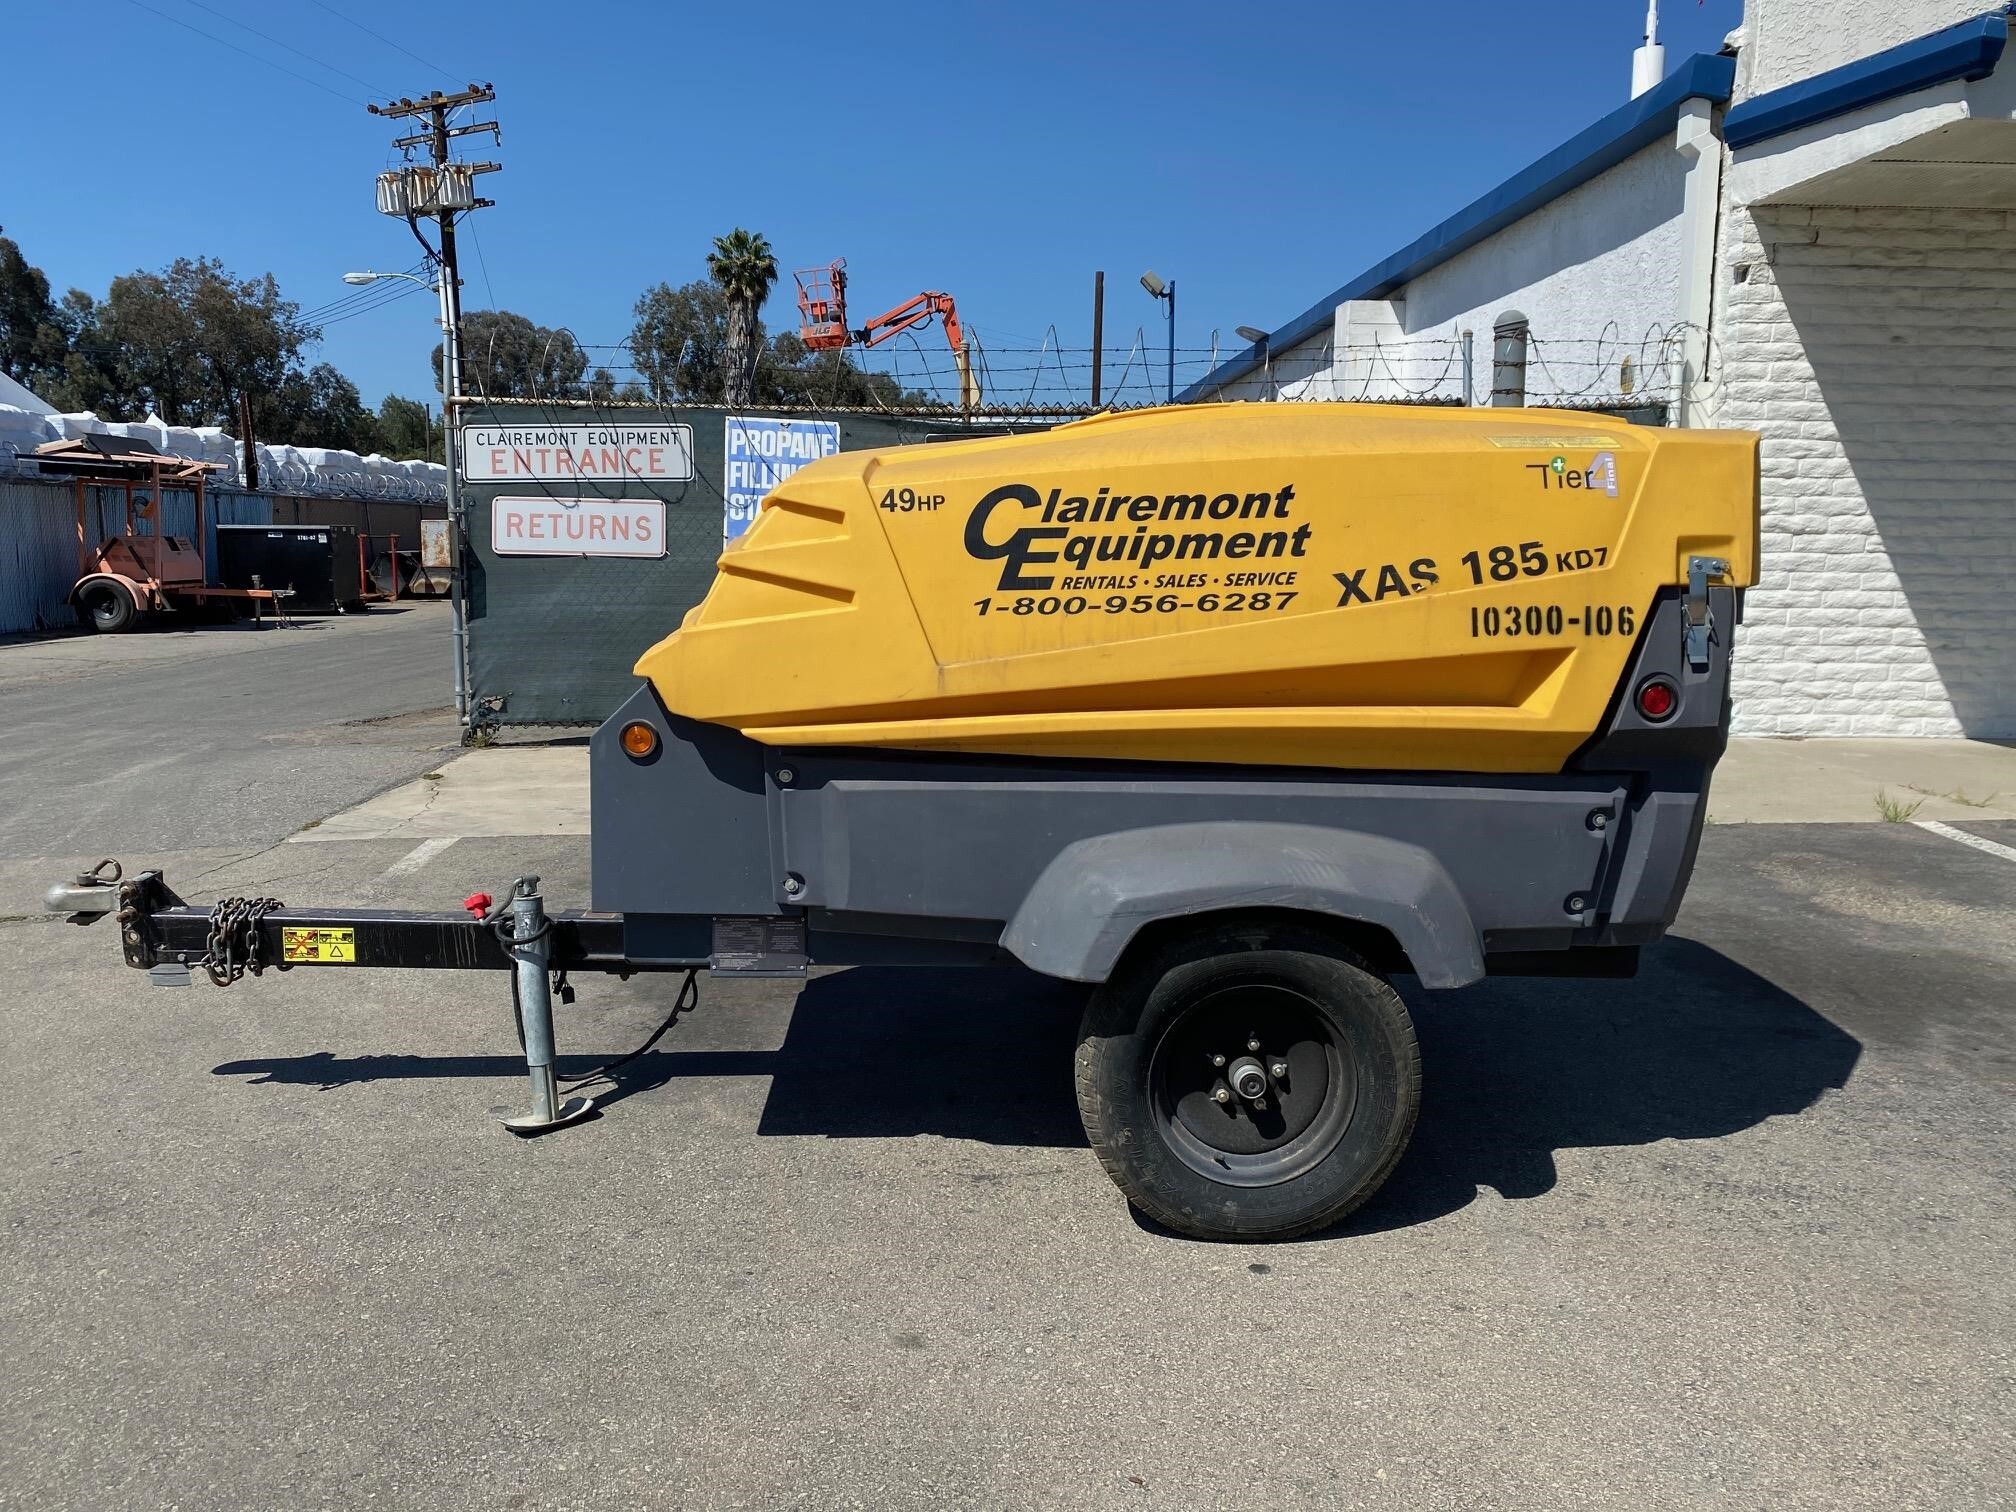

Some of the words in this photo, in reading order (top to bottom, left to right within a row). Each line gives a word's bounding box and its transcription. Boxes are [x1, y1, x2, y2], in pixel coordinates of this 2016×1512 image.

[476, 432, 578, 446] CLAIREMONT
[588, 431, 679, 446] EQUIPMENT
[731, 429, 834, 459] PROPANE
[491, 448, 665, 475] ENTRANCE
[730, 461, 806, 489] FILLIN
[880, 488, 946, 513] 49HP
[506, 512, 652, 542] RETURNS
[964, 484, 1295, 560] Clairemont
[997, 522, 1312, 591] Equipment
[1060, 575, 1138, 590] RENTALS
[1153, 573, 1208, 589] SALES
[1223, 571, 1298, 587] SERVICE
[1332, 558, 1440, 607] XAS
[1461, 541, 1549, 585] 185
[1556, 546, 1608, 573] KD7
[972, 591, 1299, 616] 1-800-956-6287
[1471, 605, 1635, 638] 10300-106
